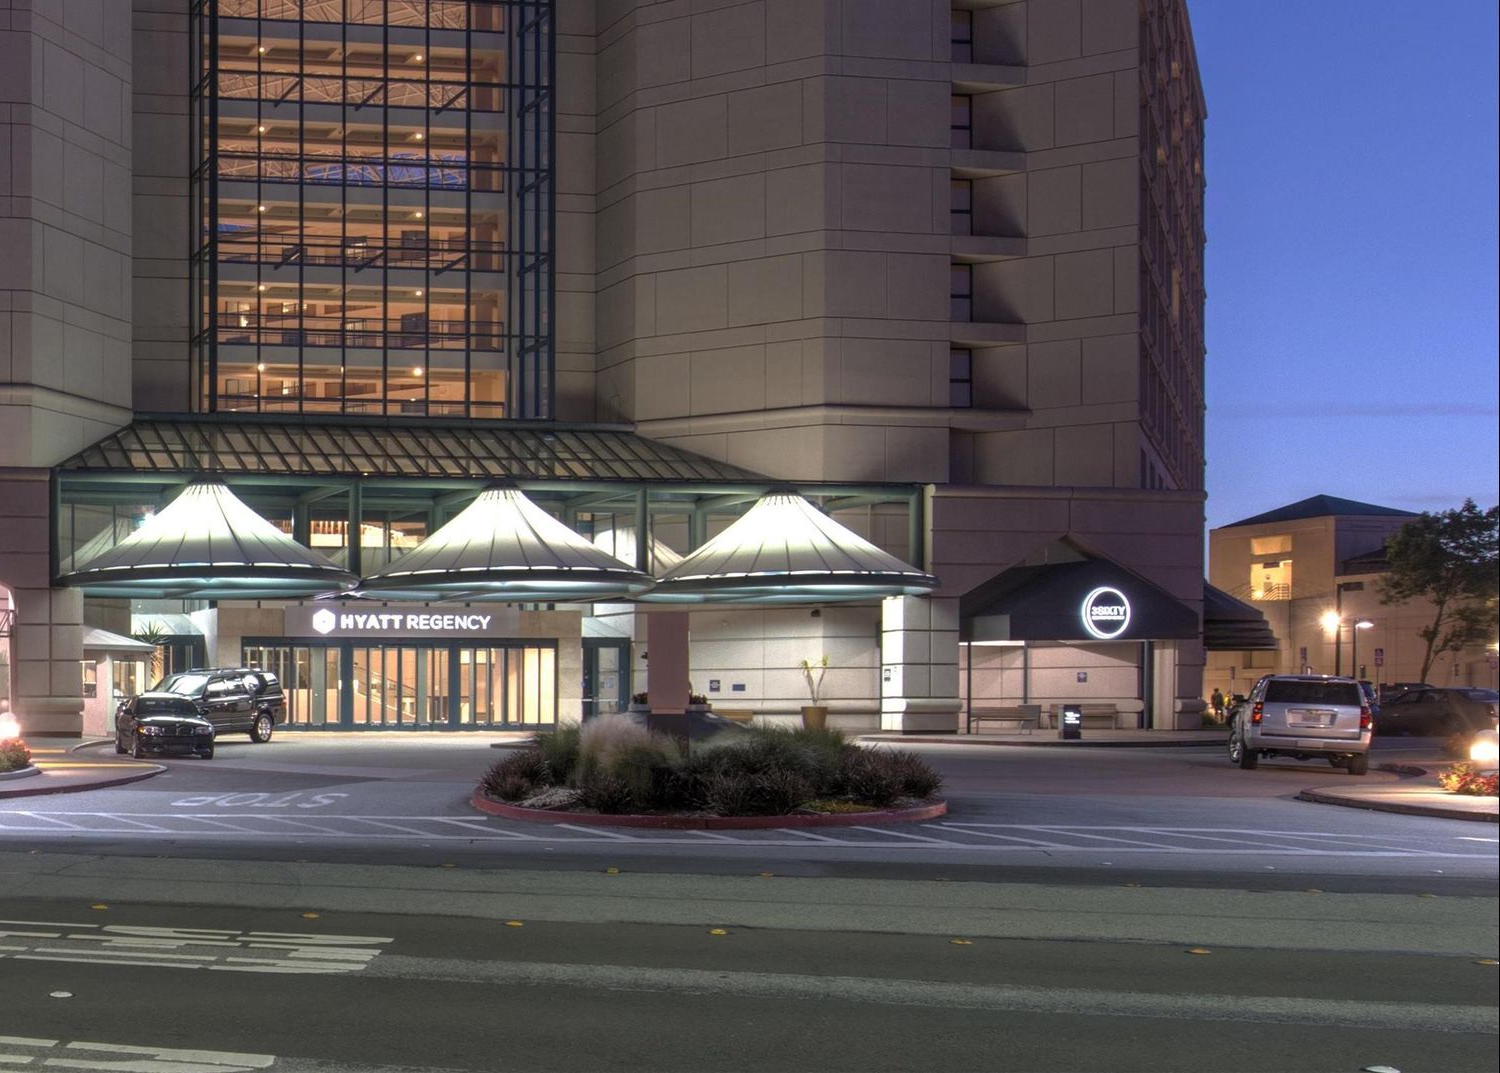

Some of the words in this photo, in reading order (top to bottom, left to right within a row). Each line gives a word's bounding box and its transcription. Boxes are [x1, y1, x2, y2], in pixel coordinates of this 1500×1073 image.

[340, 614, 403, 630] HYATT
[406, 614, 491, 630] REGENCY
[170, 792, 349, 808] STOP
